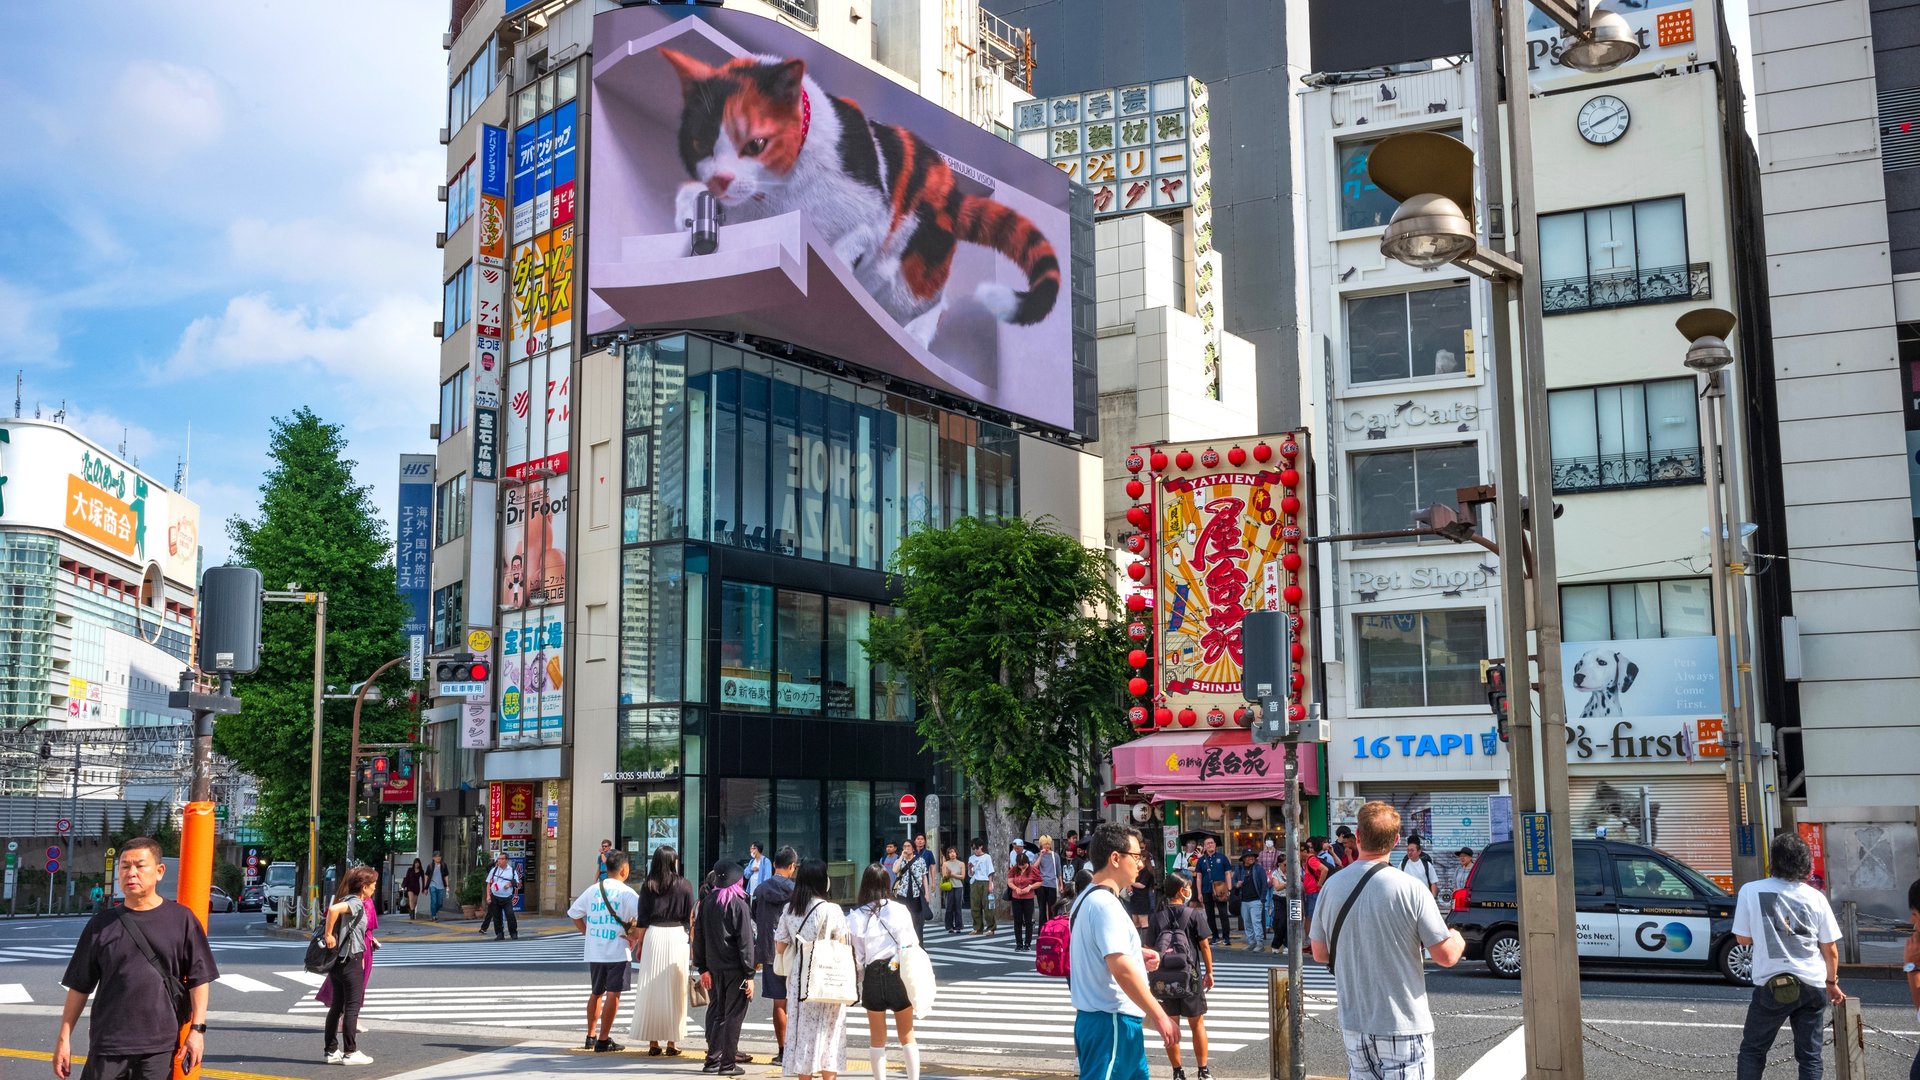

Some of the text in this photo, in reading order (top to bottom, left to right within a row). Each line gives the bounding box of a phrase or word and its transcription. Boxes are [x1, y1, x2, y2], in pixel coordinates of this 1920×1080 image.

[1659, 12, 1690, 22] Pets
[1660, 19, 1691, 30] always
[1660, 26, 1691, 37] come
[1661, 33, 1692, 44] first
[1019, 88, 1147, 130] 服飾手芸
[1054, 113, 1184, 154] 洋装材料
[947, 157, 996, 189] SHINJUKU VISION
[562, 226, 574, 241] 5F
[483, 326, 495, 335] 4F
[1343, 408, 1401, 432] Cat
[477, 412, 494, 477] 宝石広場
[81, 449, 127, 499] たのめーる
[402, 462, 431, 476] HIS
[1188, 474, 1256, 490] YATAIEN
[71, 490, 132, 543] 大塚商会
[506, 505, 525, 526] Dr
[530, 495, 569, 520] Foot
[400, 505, 414, 588] エイチ・アイ・エス
[413, 505, 429, 589] 海外・国内旅行
[1350, 566, 1487, 593] Pet Shop
[503, 621, 563, 656] 宝石広場
[1673, 657, 1697, 669] Pets
[1676, 671, 1715, 683] Always
[443, 683, 482, 693] 自転車専用
[1675, 686, 1705, 696] Come
[504, 705, 520, 716] SHOP
[1676, 700, 1707, 710] First.
[1353, 735, 1391, 759] 16
[1396, 733, 1473, 757] TAPI
[615, 771, 666, 780] CROSS SHINJUKU
[1534, 816, 1548, 873] 防犯カメラ作動中
[589, 927, 617, 941] CLUB
[1593, 932, 1616, 941] Next.
[1635, 921, 1693, 953] GO
